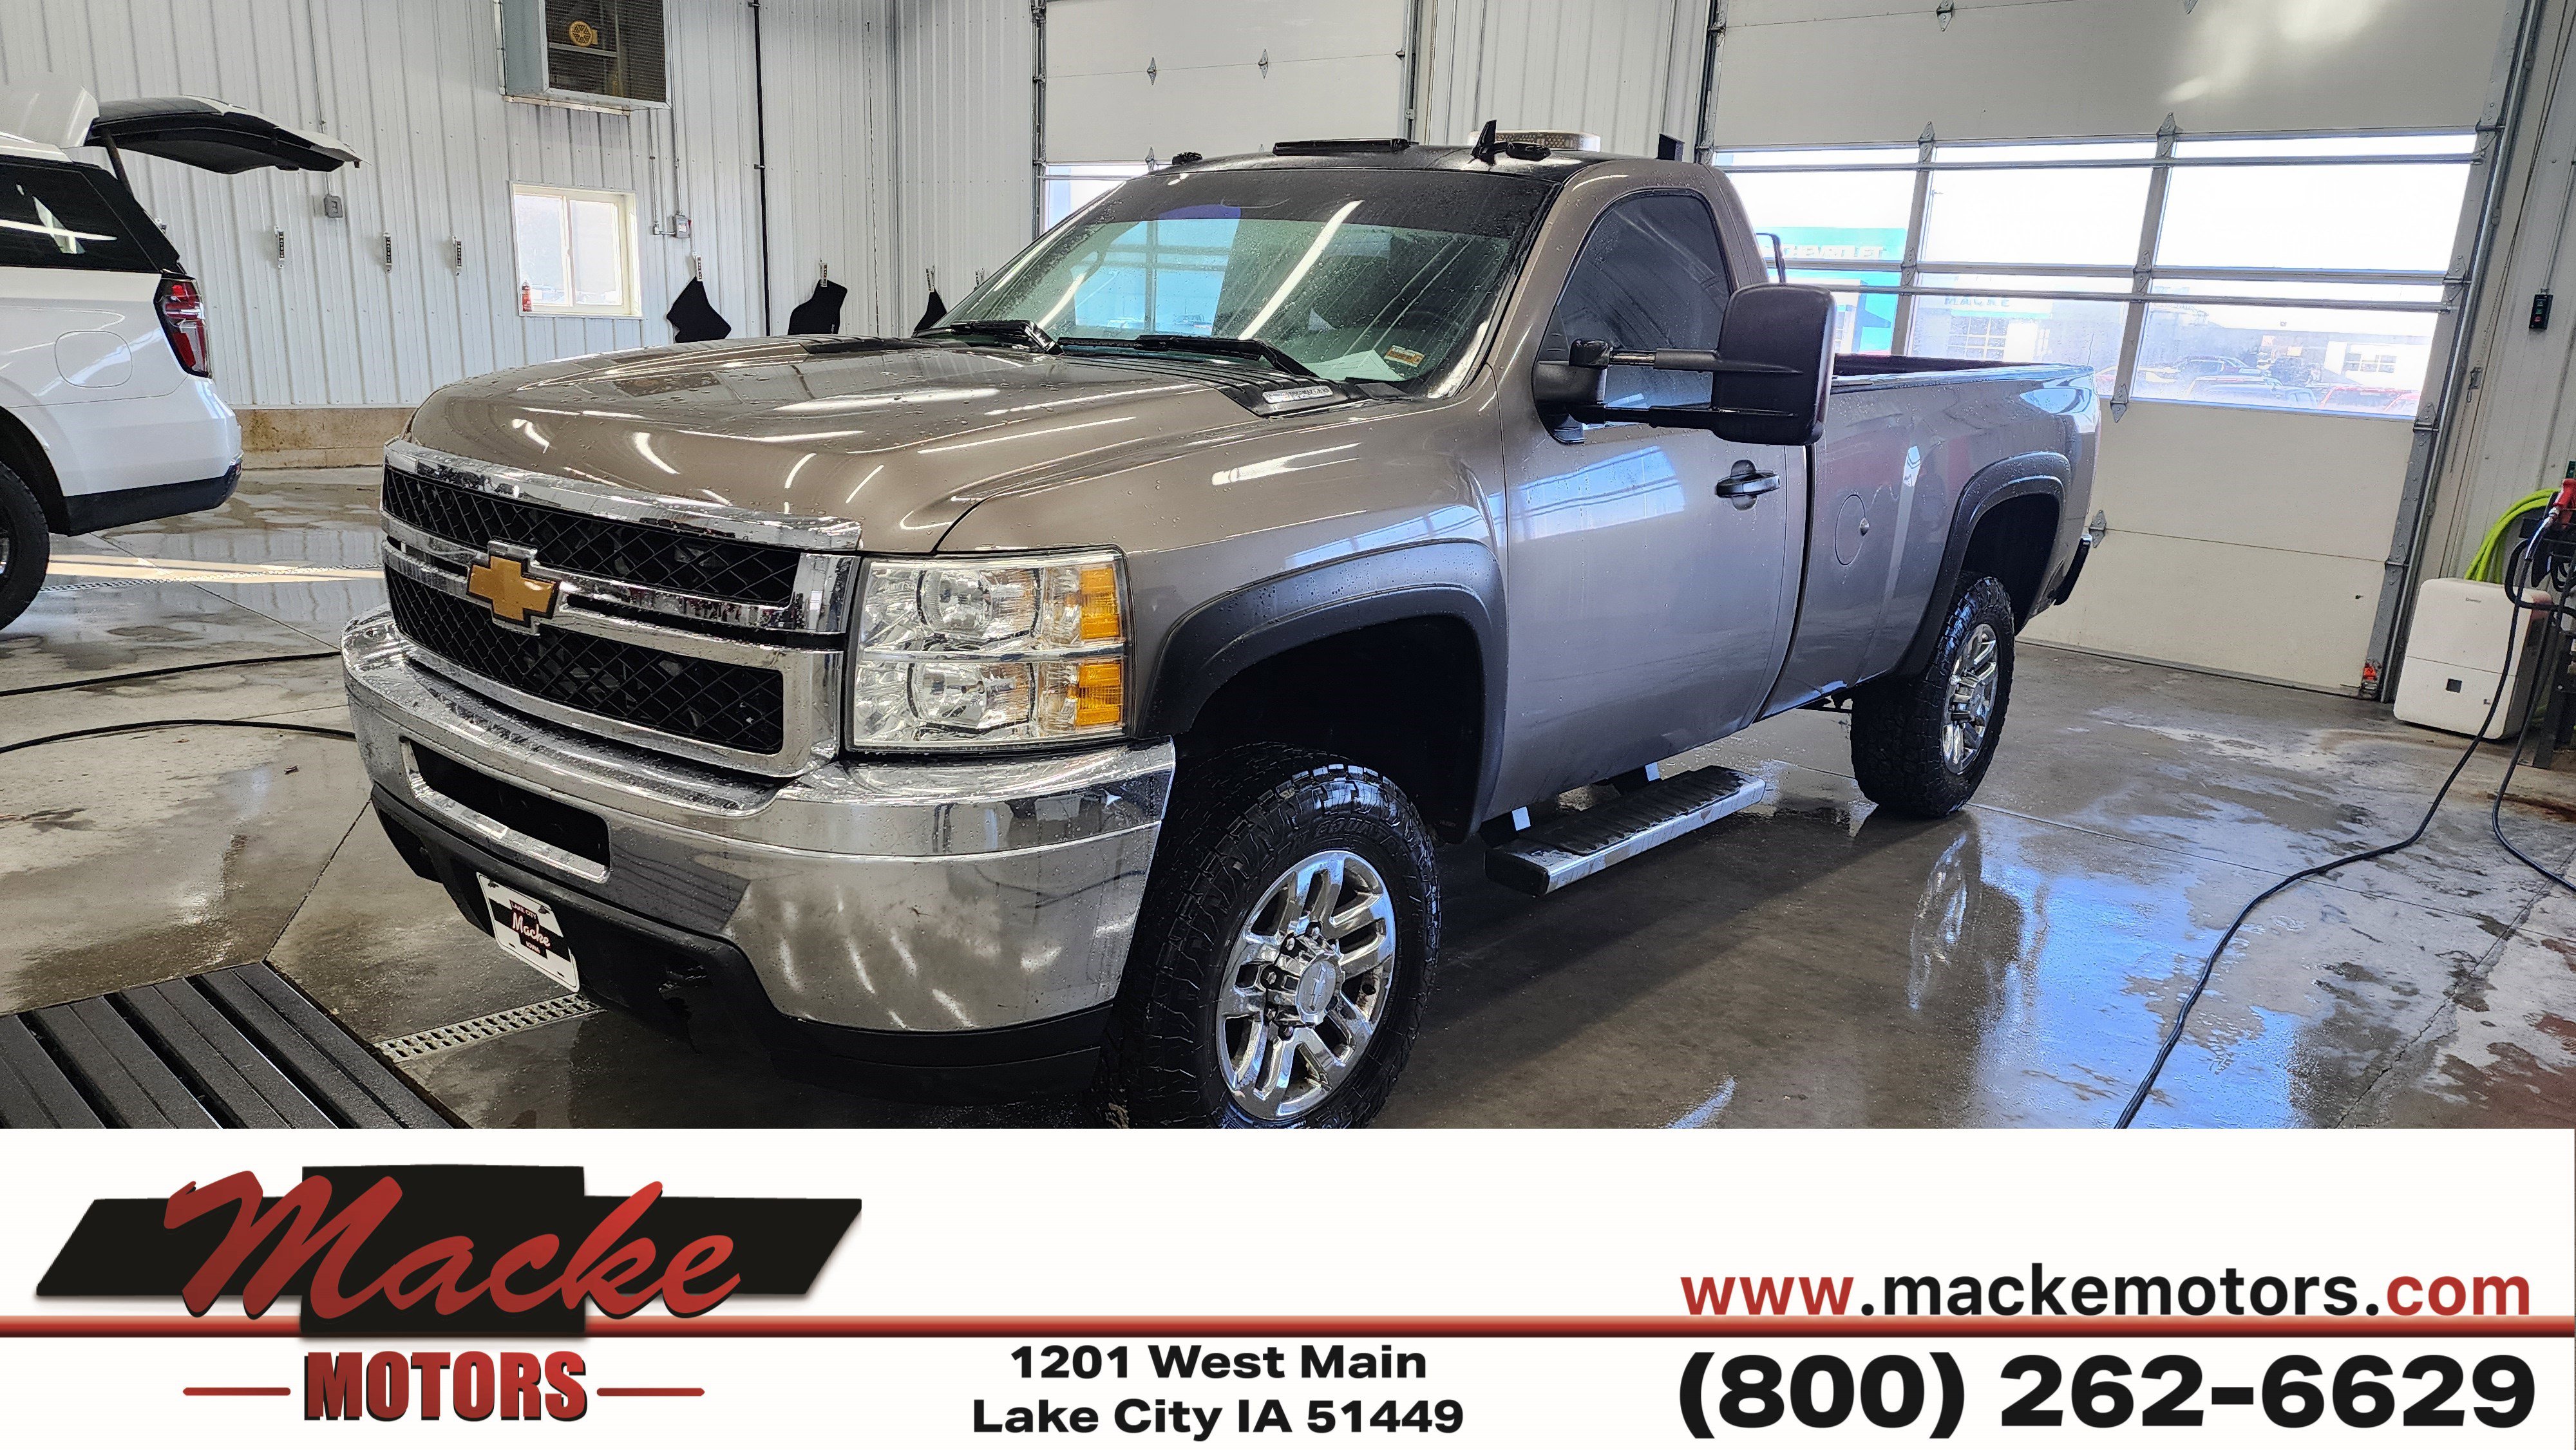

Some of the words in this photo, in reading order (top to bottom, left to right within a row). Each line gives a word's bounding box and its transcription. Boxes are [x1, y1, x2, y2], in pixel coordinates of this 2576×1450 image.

[511, 901, 526, 914] LAKE
[525, 909, 537, 919] CITY
[513, 912, 551, 947] Macke
[526, 941, 540, 954] IOWA
